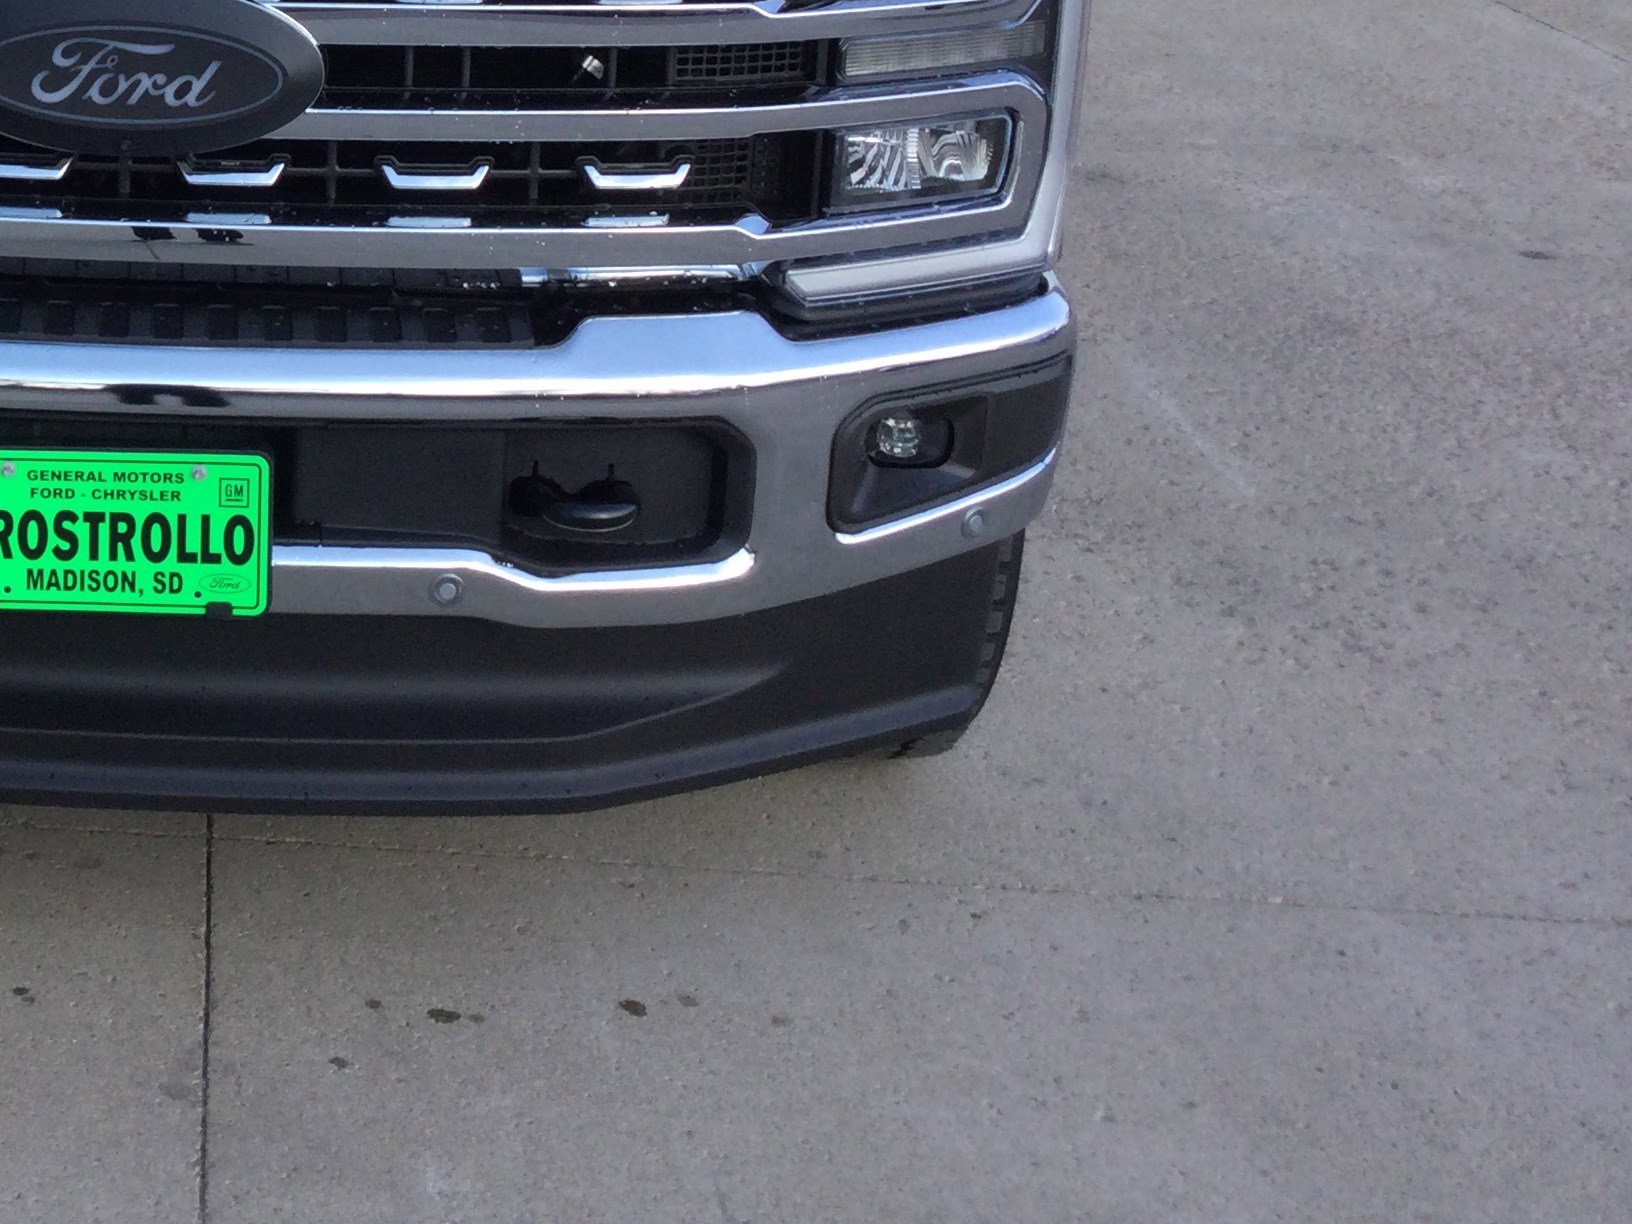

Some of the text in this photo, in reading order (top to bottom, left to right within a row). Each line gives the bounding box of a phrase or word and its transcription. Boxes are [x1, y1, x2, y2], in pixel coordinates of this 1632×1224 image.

[31, 36, 223, 108] Ford
[26, 469, 185, 485] GENERAL MOTORS
[29, 487, 77, 501] FORD
[90, 488, 182, 503] CHRYSLER
[224, 484, 244, 498] GM
[25, 568, 184, 597] MADISON, SD
[208, 576, 242, 591] Ford
